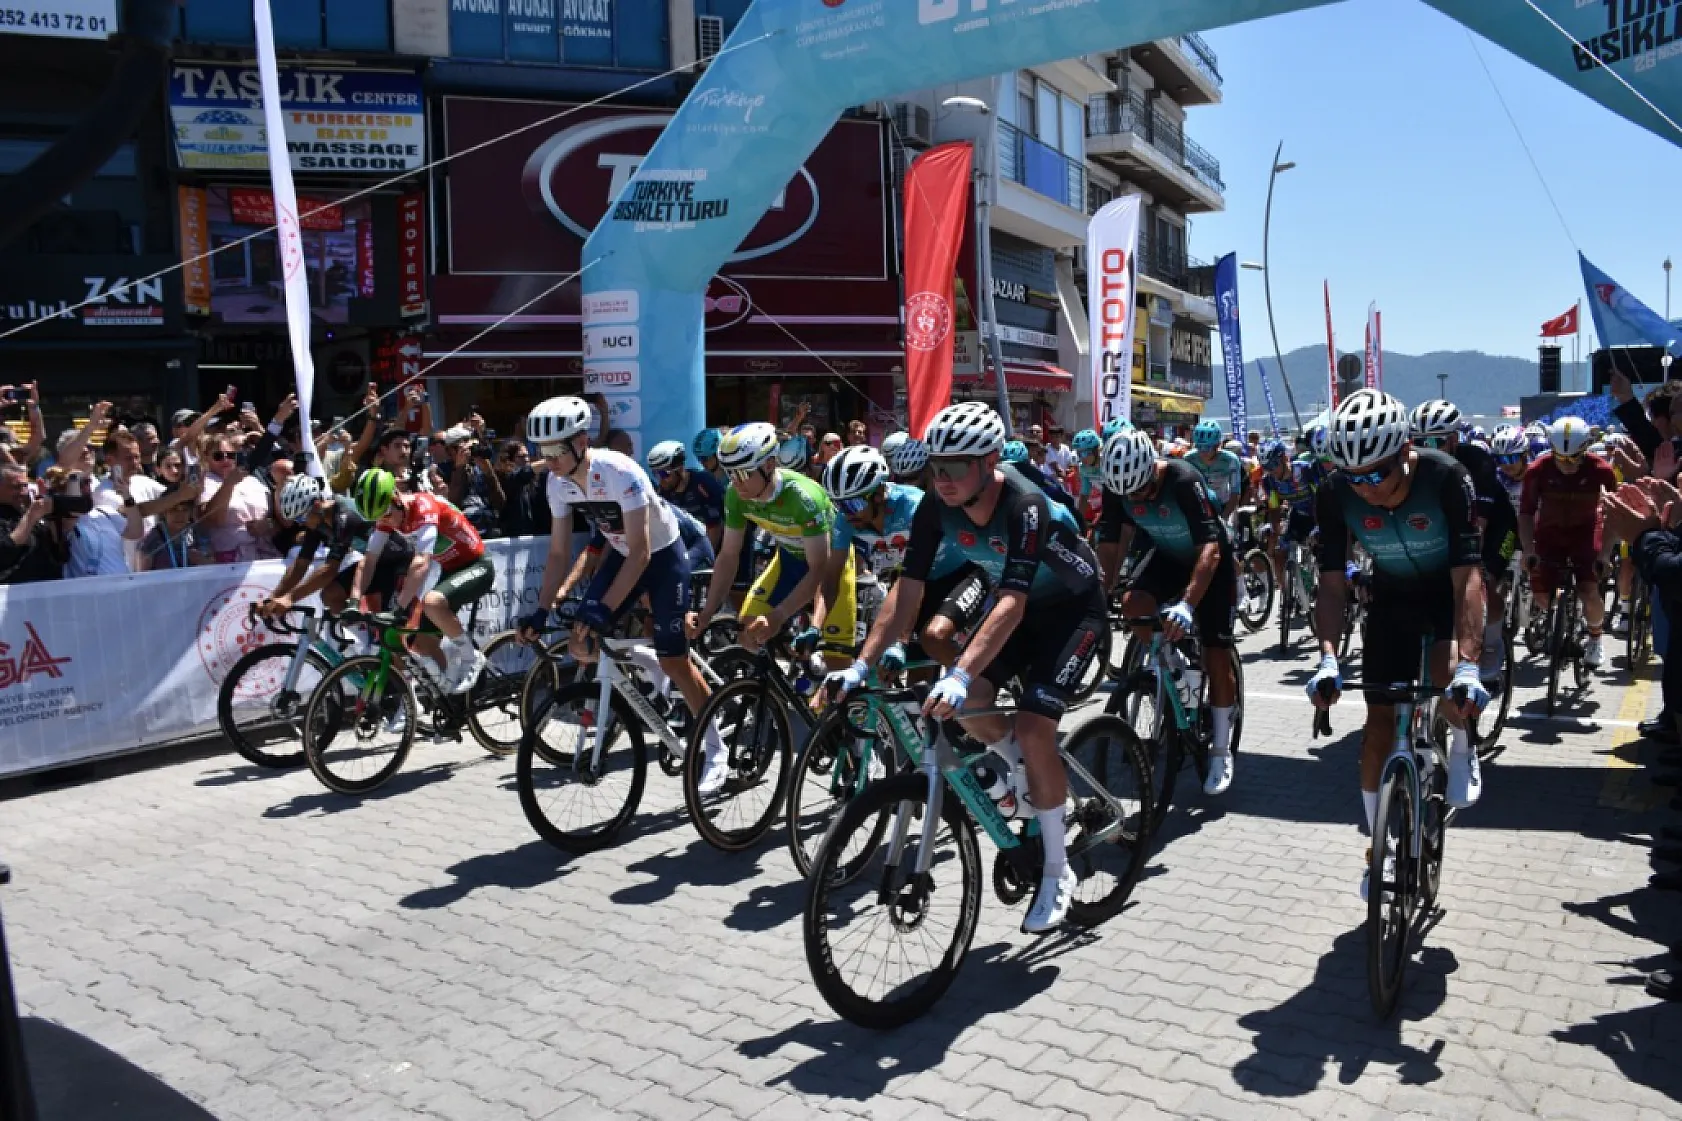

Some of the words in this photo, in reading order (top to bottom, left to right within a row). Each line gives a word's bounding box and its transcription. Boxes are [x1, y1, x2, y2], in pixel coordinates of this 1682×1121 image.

[30, 11, 60, 29] 413
[64, 14, 85, 31] 72
[88, 15, 107, 32] 01
[352, 92, 419, 106] CENTER
[289, 112, 413, 128] TURKISH
[287, 141, 419, 156] MASSAGE
[299, 156, 407, 170] SALOON
[678, 198, 729, 222] TURU
[607, 335, 633, 349] UCI
